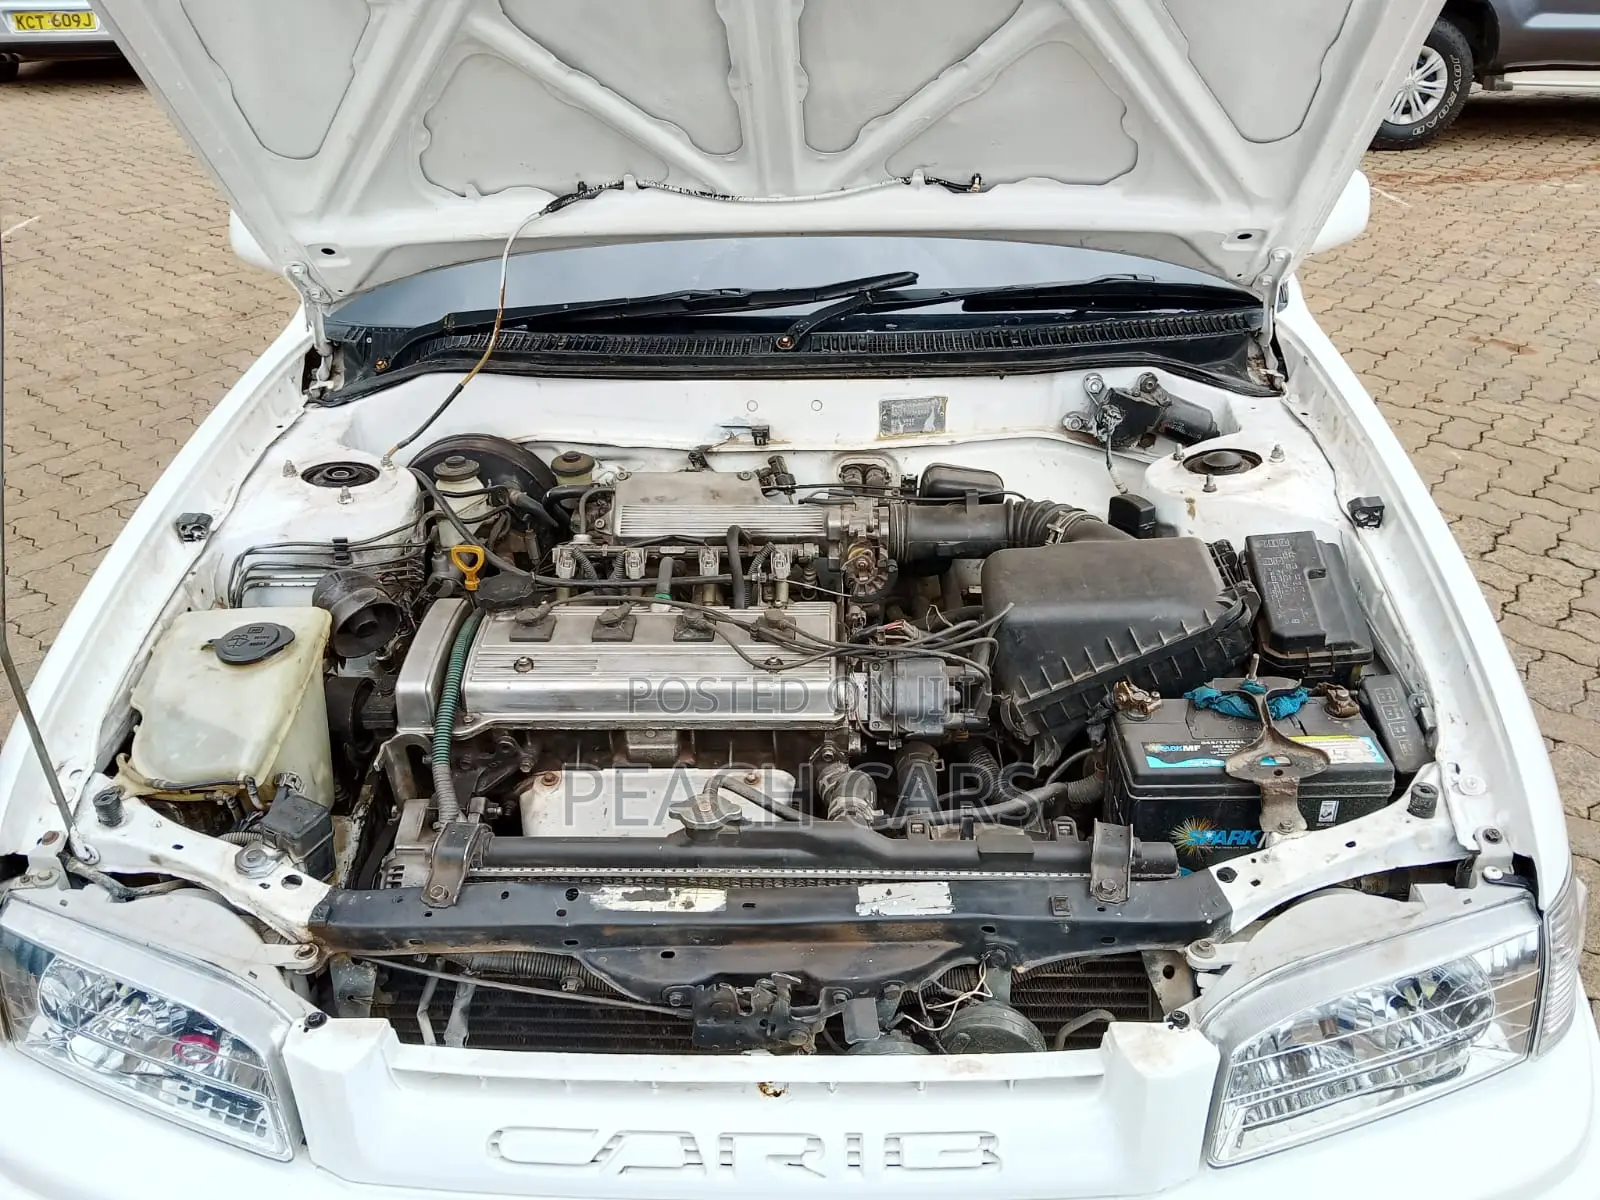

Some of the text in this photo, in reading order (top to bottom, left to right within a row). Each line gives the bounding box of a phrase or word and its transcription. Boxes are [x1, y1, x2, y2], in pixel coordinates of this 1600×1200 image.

[15, 12, 93, 30] KCT 609J
[485, 1125, 1002, 1177] CARIB
